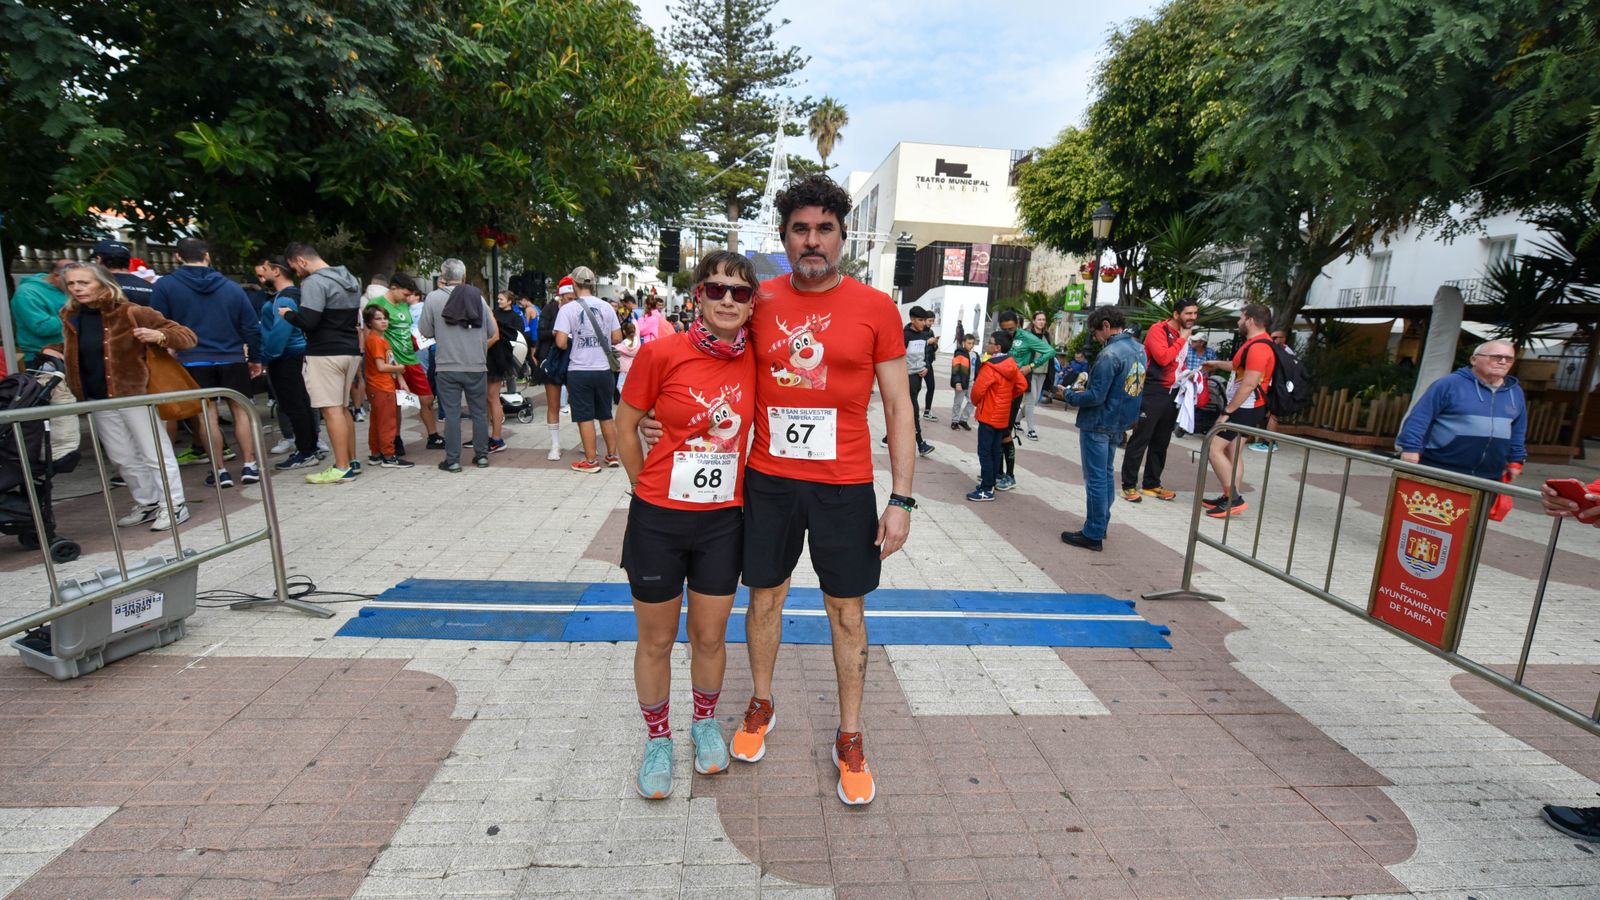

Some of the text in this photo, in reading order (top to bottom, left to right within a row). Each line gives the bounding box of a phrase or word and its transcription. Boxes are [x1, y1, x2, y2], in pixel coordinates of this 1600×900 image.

[915, 176, 990, 187] TEATRO MUNICIPAL
[915, 183, 989, 193] ALAMEDA
[786, 422, 816, 444] 67
[693, 467, 722, 488] 68
[1400, 582, 1430, 600] Excmo.
[114, 593, 162, 615] FINISHER
[124, 604, 152, 617] CRONO
[1378, 586, 1448, 620] AYUNTAMIENTO
[1389, 601, 1433, 626] DE TARIFA
